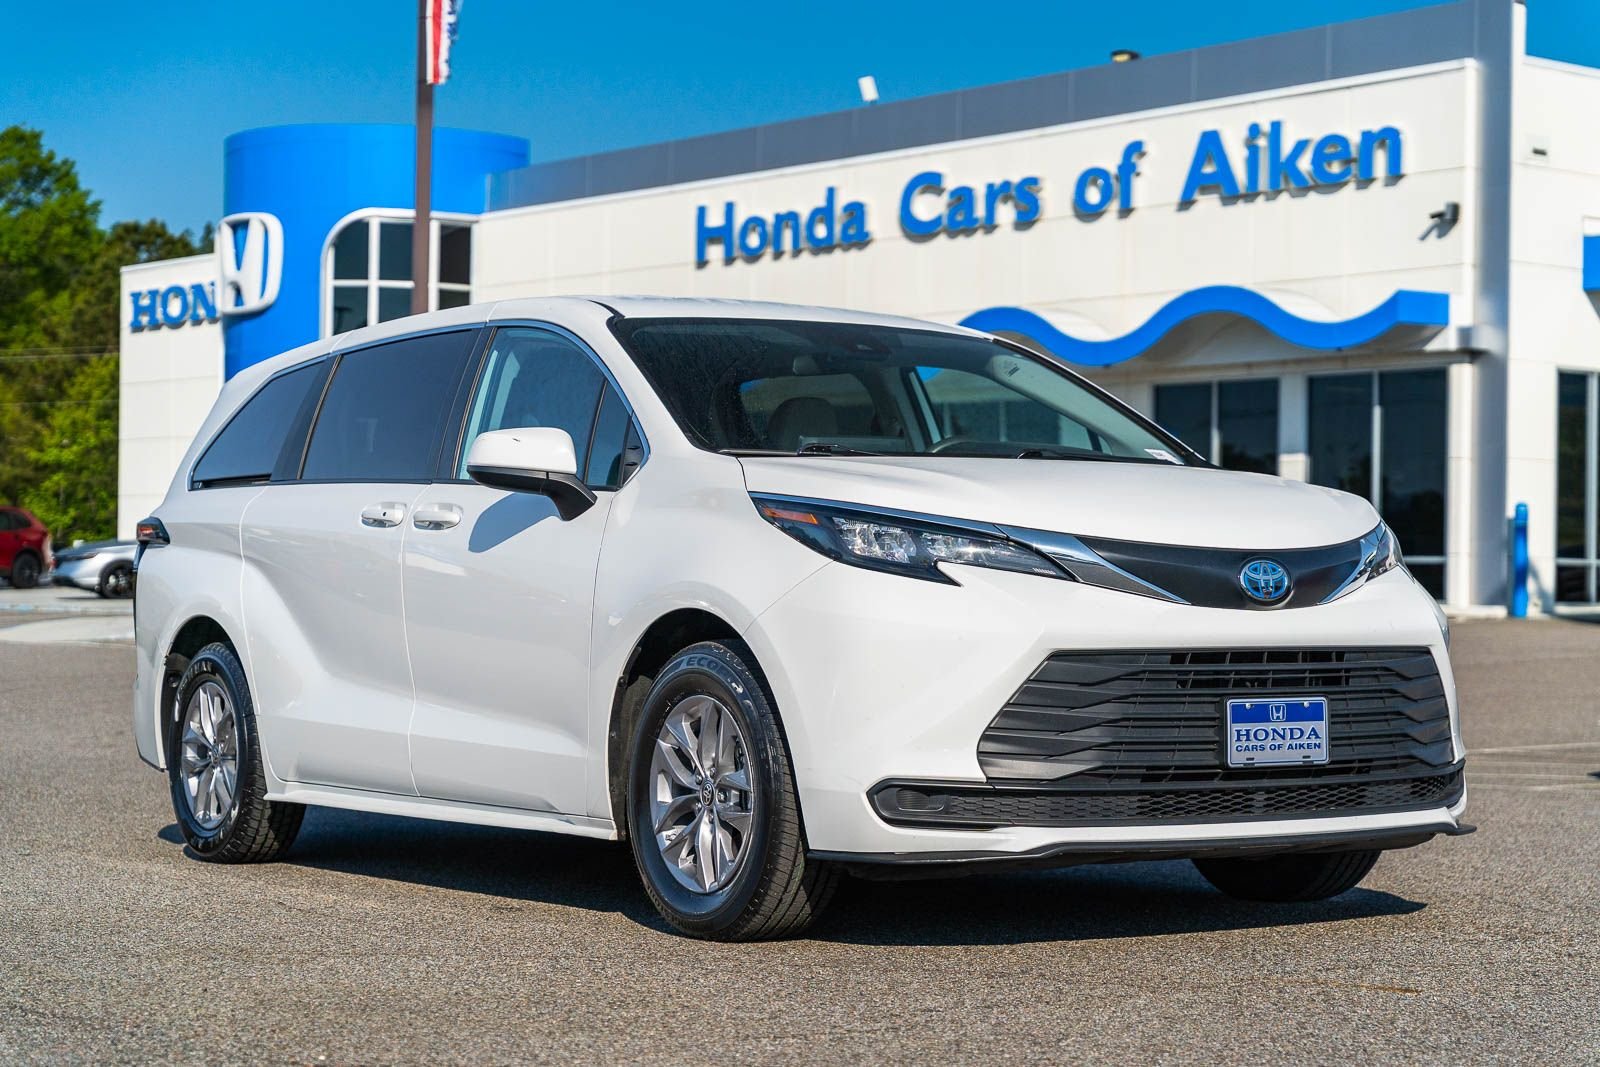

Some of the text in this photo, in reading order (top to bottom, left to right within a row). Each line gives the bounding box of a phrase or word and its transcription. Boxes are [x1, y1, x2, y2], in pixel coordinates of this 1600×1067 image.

[696, 120, 1403, 264] Honda Cars of Aiken
[1235, 727, 1321, 742] HONDA
[1235, 742, 1321, 752] CARS OF AIKEN
